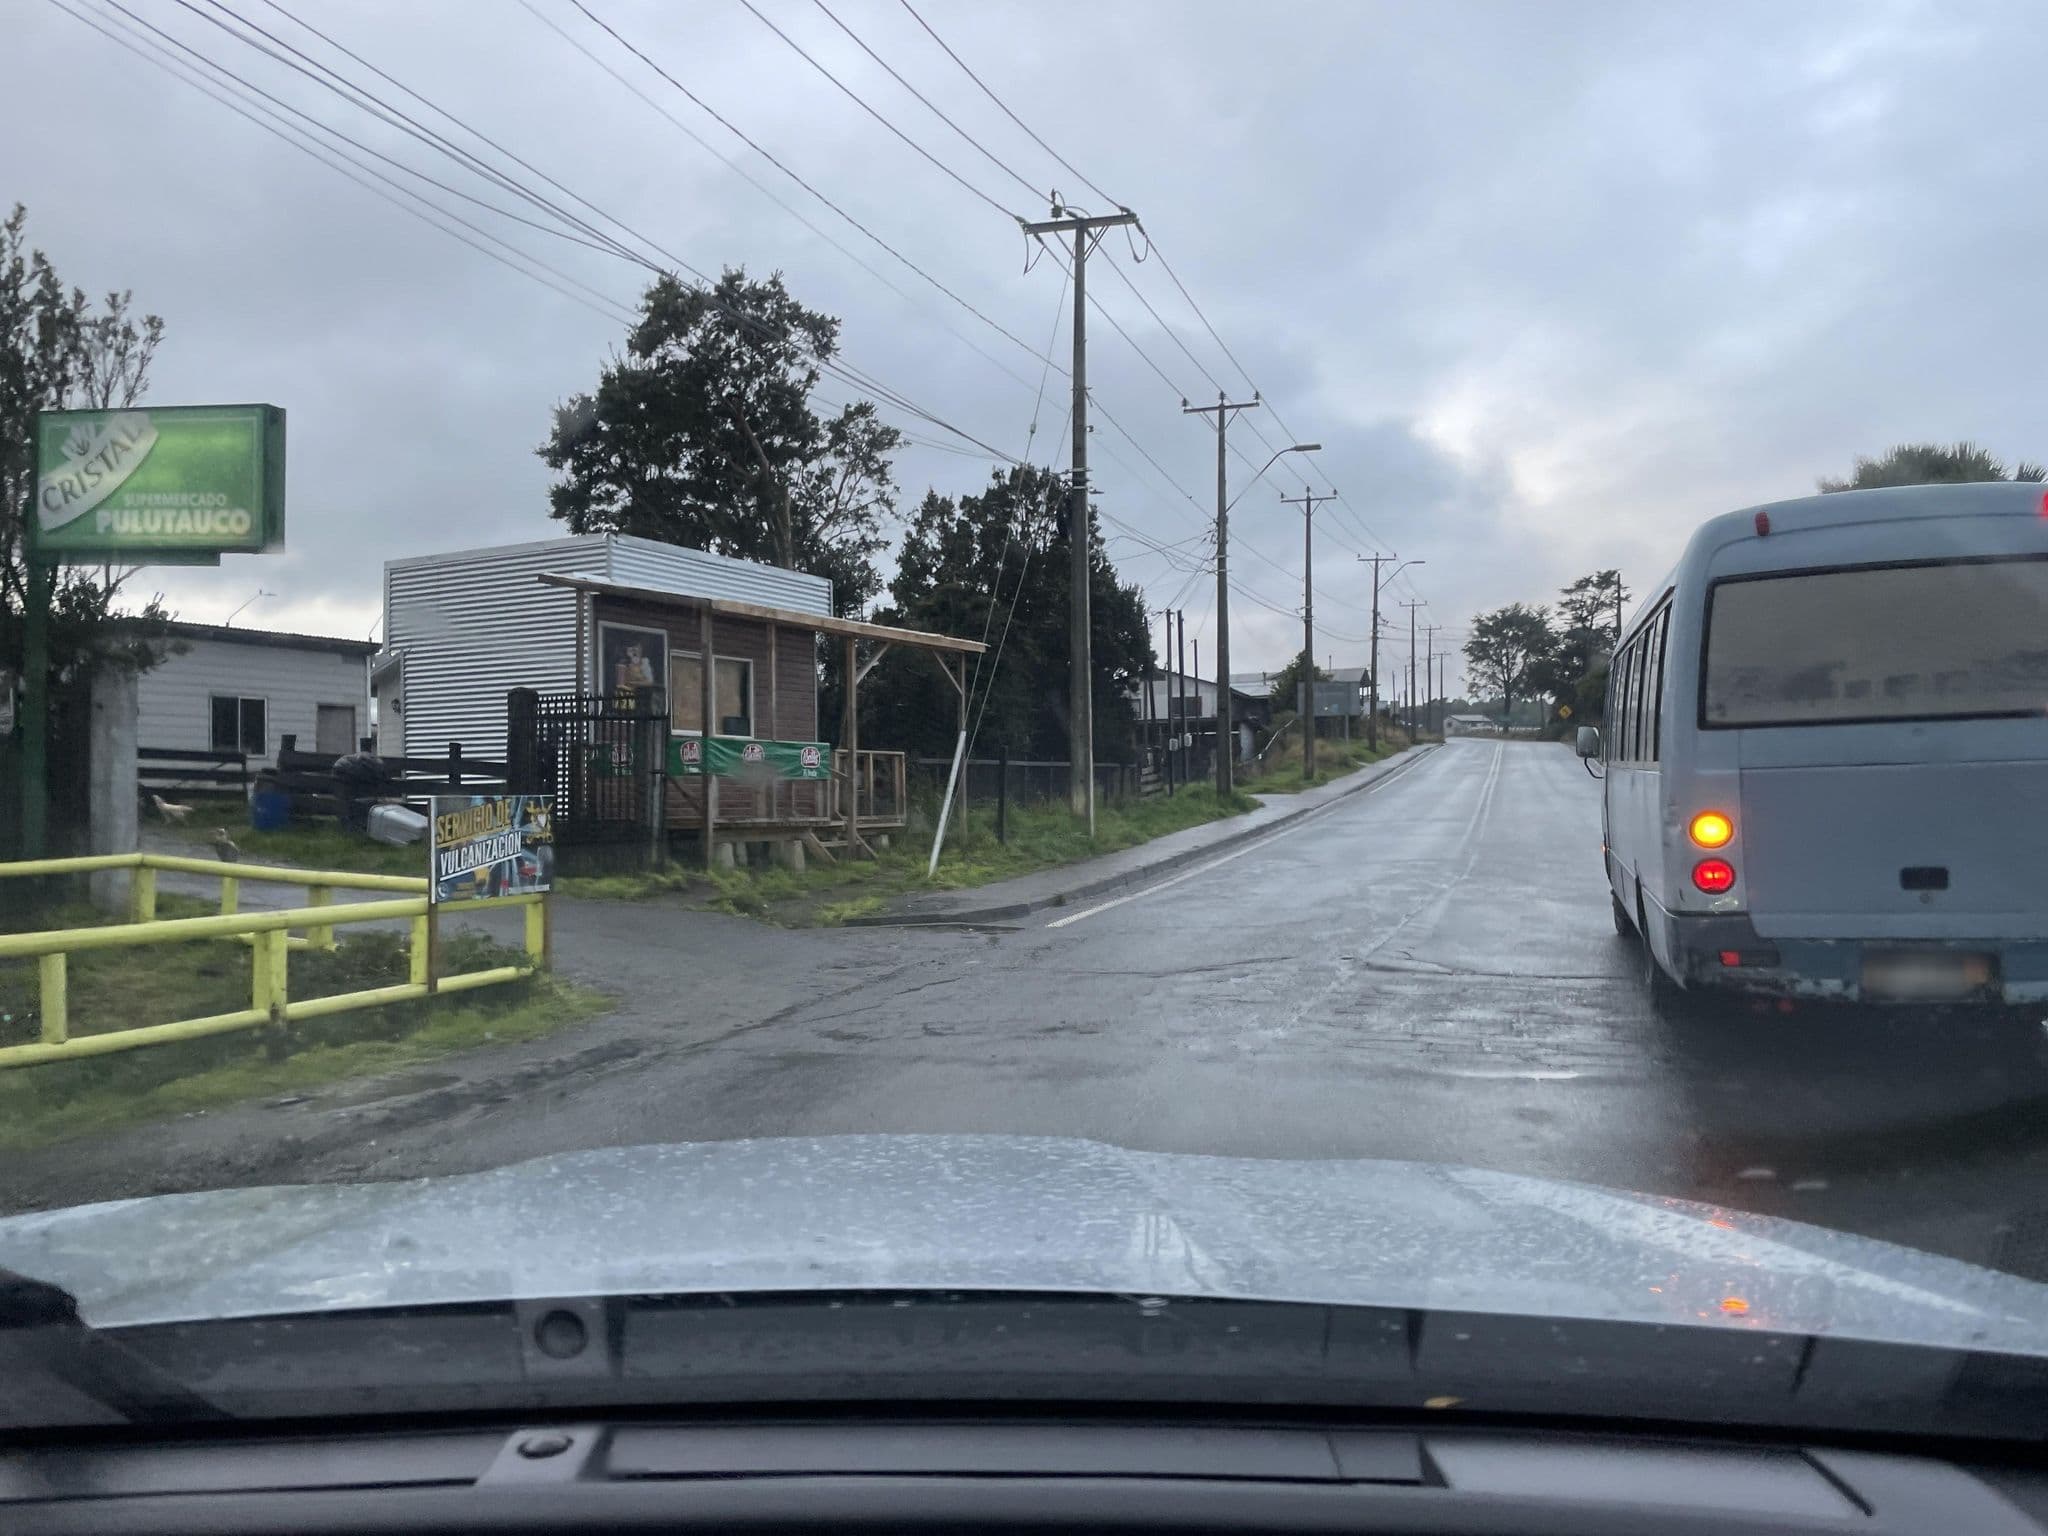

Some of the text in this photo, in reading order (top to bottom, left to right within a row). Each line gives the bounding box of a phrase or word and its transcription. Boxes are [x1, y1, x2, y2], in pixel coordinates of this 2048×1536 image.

[41, 424, 144, 512] CRISTAL
[96, 509, 250, 533] PULUTAUCO
[437, 800, 511, 843] SERVICIO DE
